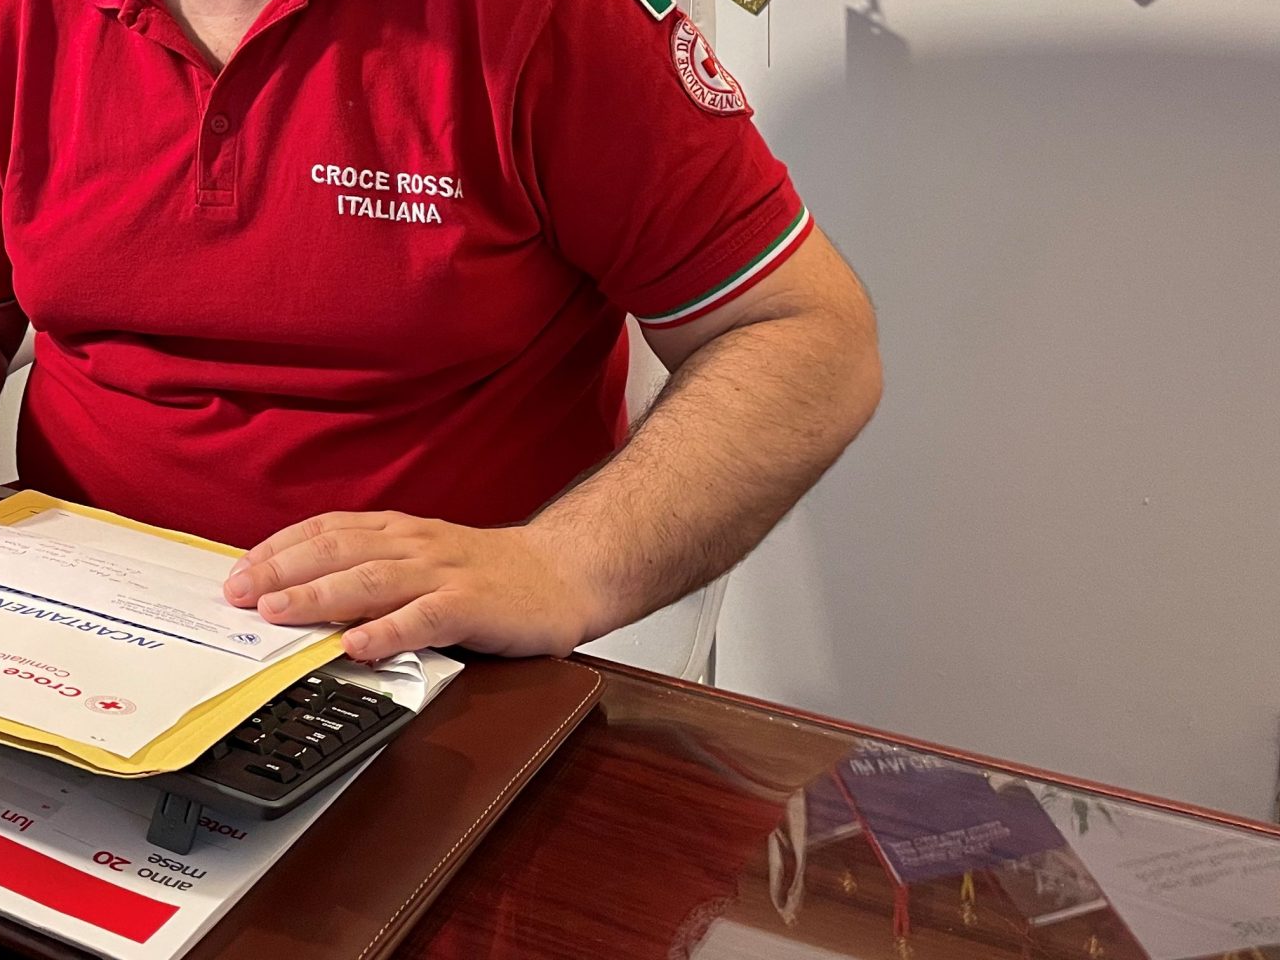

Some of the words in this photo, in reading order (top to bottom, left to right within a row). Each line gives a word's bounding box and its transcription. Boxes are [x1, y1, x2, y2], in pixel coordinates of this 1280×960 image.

[311, 163, 390, 191] CROCE
[396, 172, 464, 199] ROSSA
[337, 194, 442, 224] ITALIANA
[3, 666, 83, 698] Croce
[0, 809, 35, 832] lun
[197, 815, 249, 841] note
[92, 851, 132, 872] 20
[147, 852, 207, 880] mese
[137, 867, 193, 892] anno
